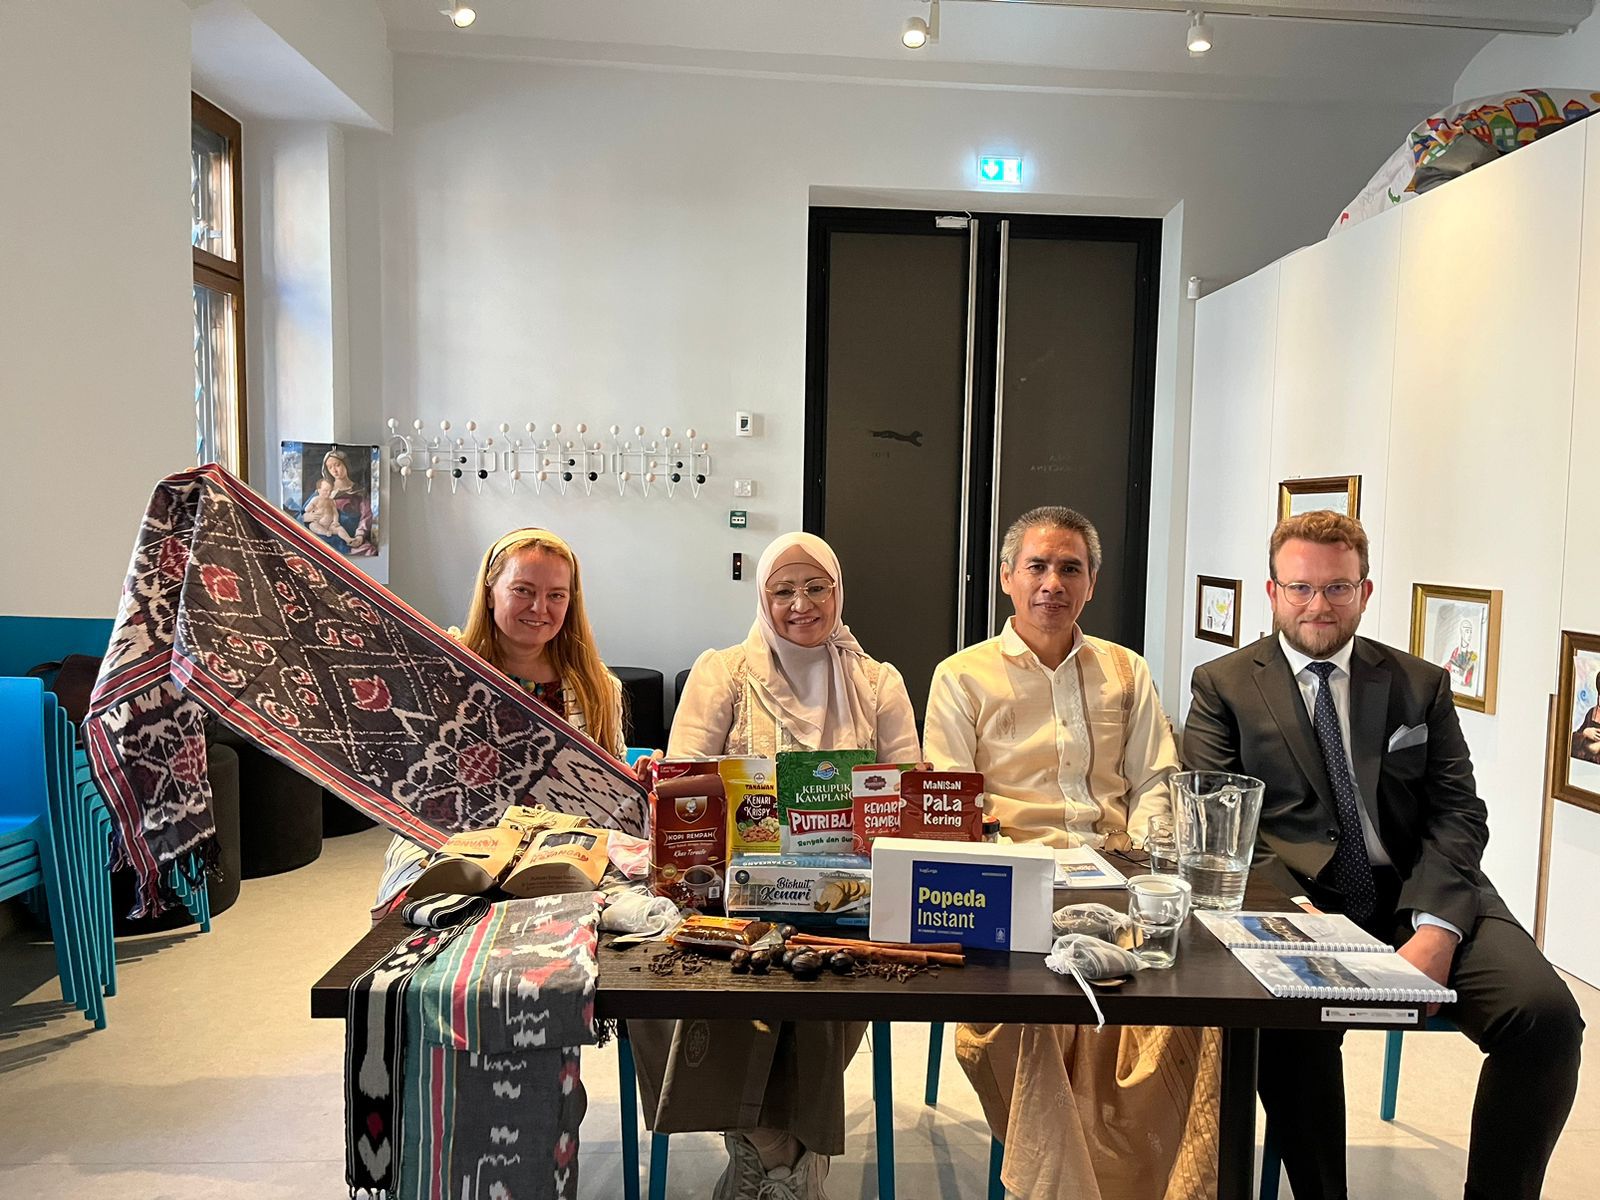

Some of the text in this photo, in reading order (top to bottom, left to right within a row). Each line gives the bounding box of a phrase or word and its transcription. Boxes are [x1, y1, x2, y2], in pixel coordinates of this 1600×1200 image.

[802, 784, 851, 794] KERUPUK
[743, 795, 771, 807] KENARI
[864, 802, 900, 814] KENAR
[743, 807, 771, 820] KRISPY
[923, 812, 962, 828] Kering
[790, 812, 830, 831] PUTRI
[777, 877, 815, 889] Biskuit
[761, 886, 812, 901] Kenari
[918, 887, 986, 909] Popeda
[917, 908, 975, 929] Instant
